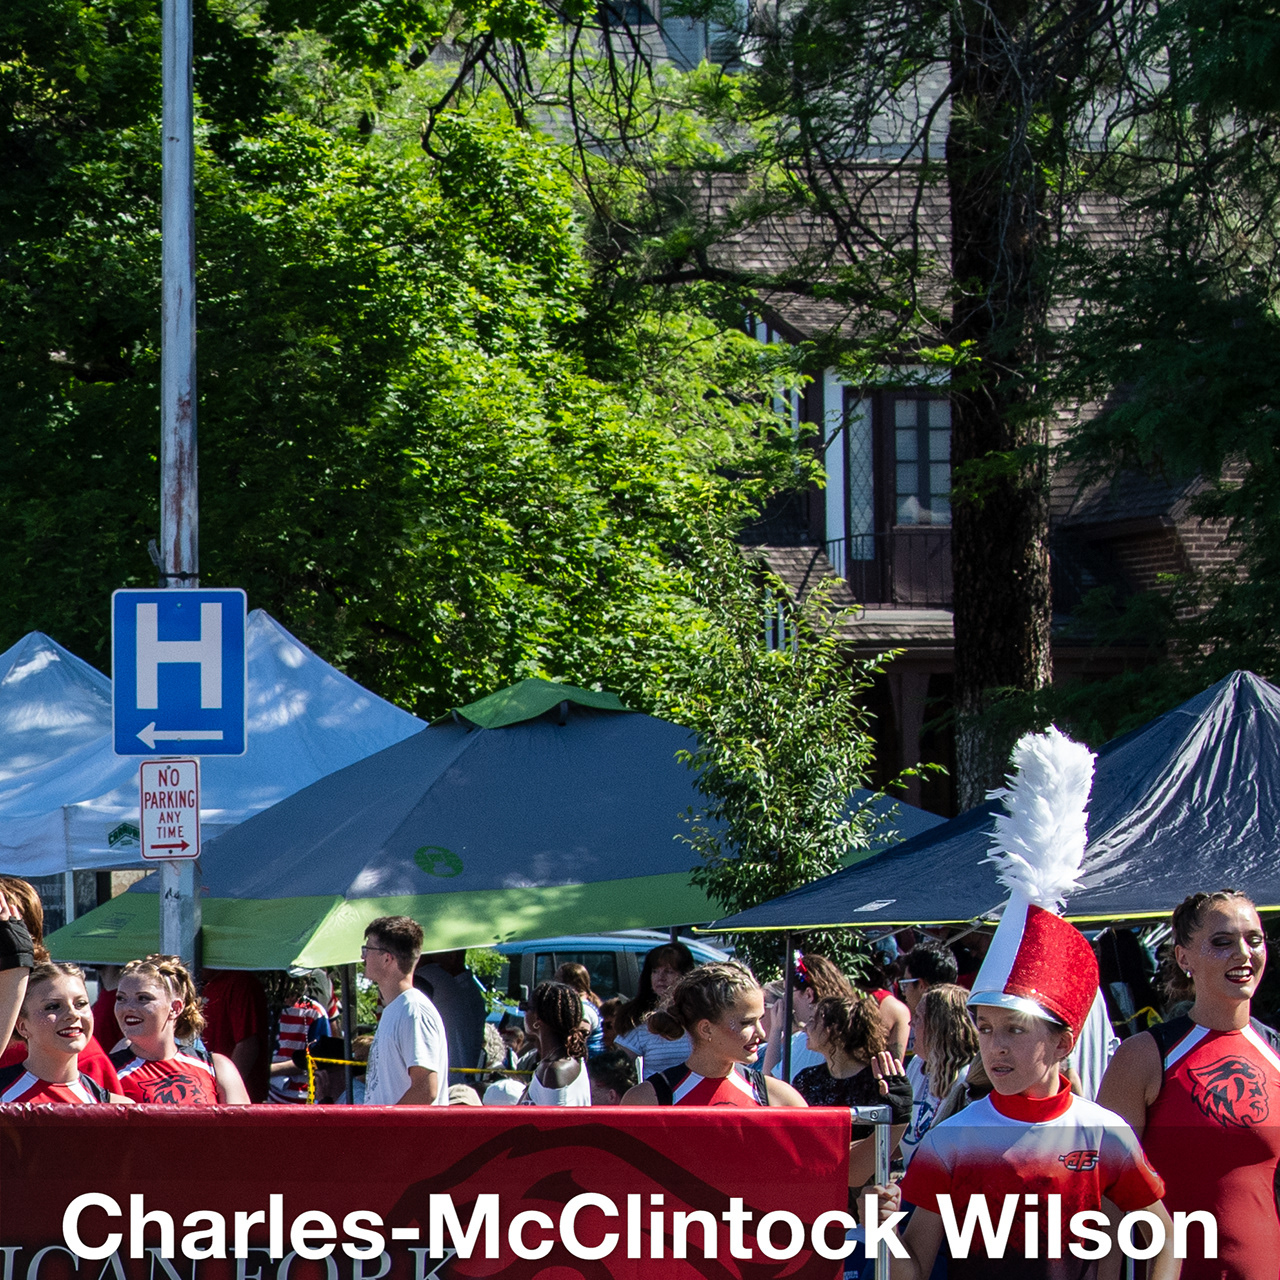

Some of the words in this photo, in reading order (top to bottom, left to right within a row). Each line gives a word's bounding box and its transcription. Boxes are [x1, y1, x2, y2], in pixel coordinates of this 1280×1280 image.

[136, 603, 222, 709] H
[158, 768, 180, 787] NO
[144, 790, 195, 809] PARKING
[159, 811, 181, 824] ANY
[156, 826, 184, 839] TIME
